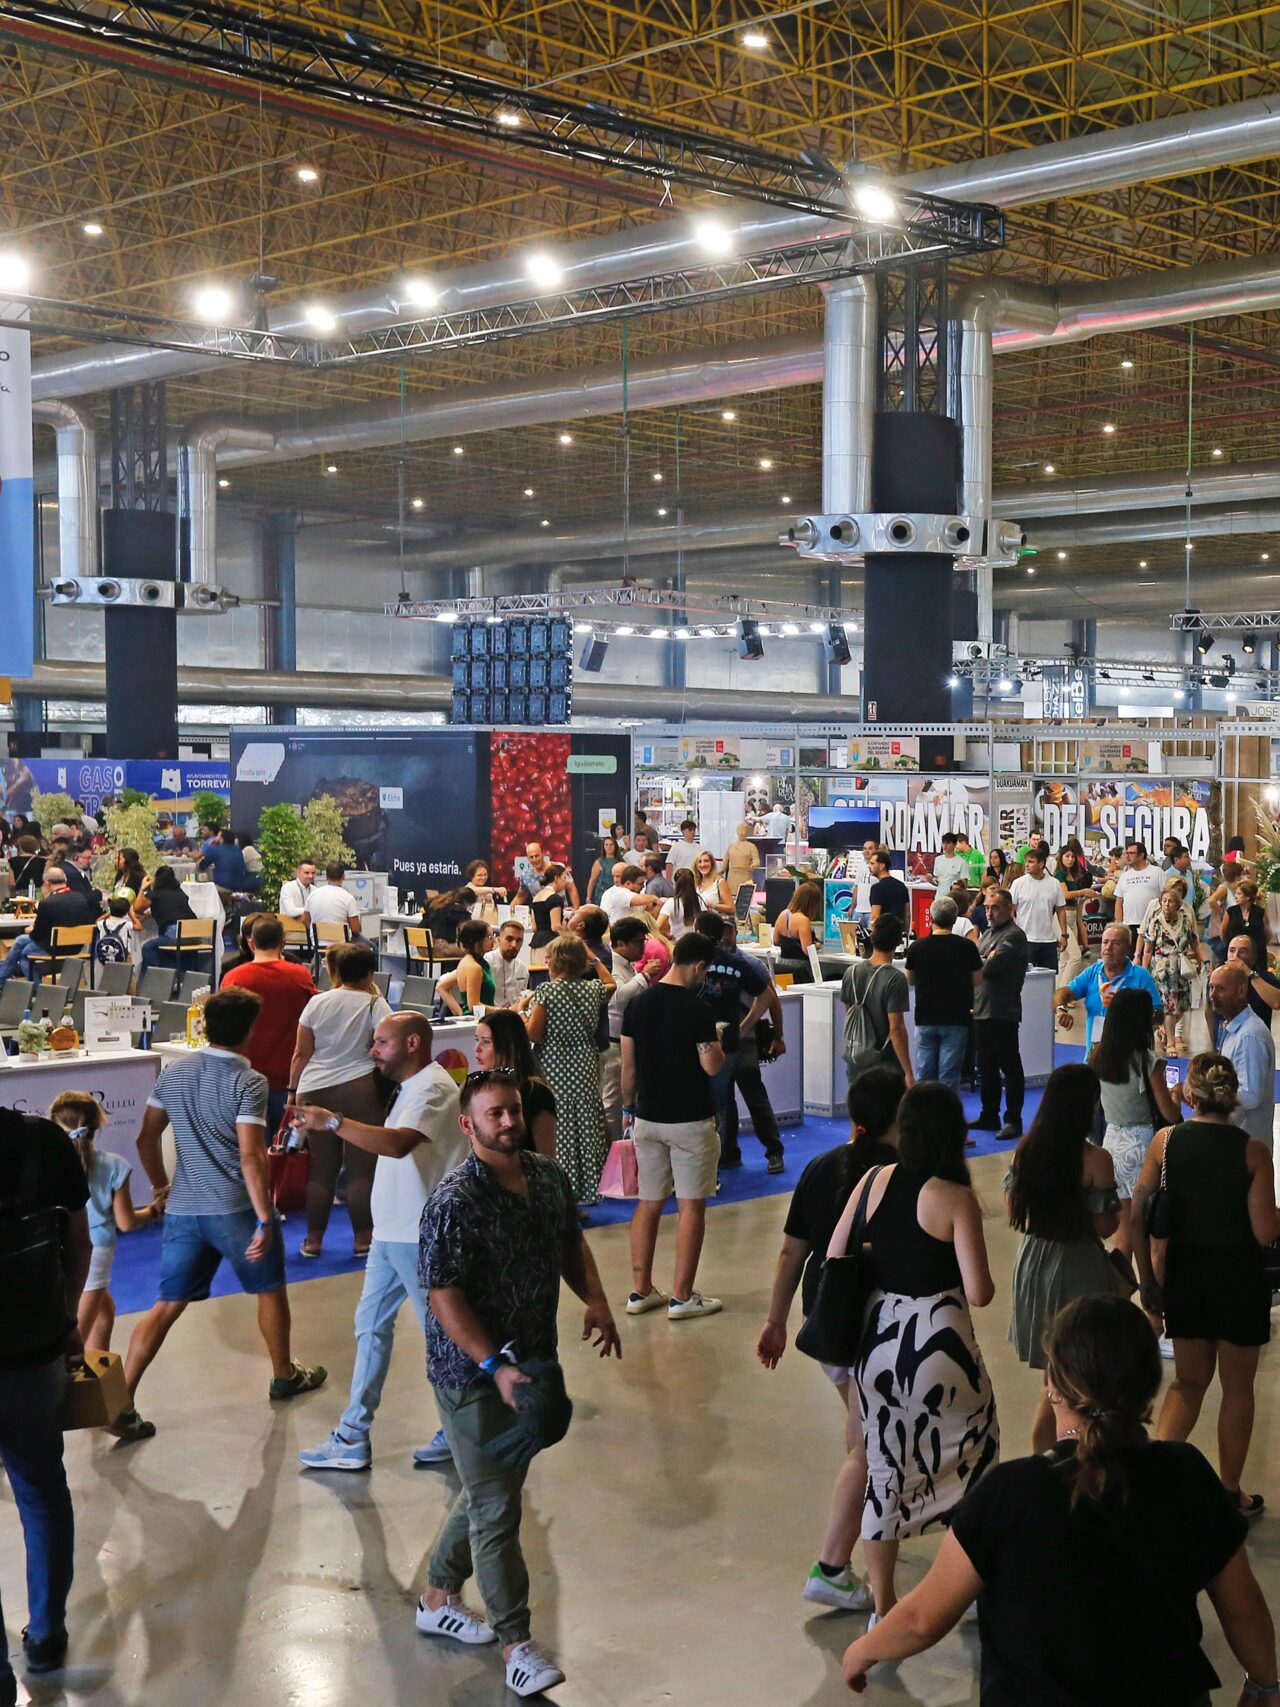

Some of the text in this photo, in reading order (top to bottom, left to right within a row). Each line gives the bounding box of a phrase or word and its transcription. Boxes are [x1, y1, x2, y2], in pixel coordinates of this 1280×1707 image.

[1251, 706, 1280, 717] JOSE
[1044, 804, 1093, 856] DEL
[1100, 804, 1211, 862] SEGURA
[393, 858, 462, 875] Pues ya estaría.
